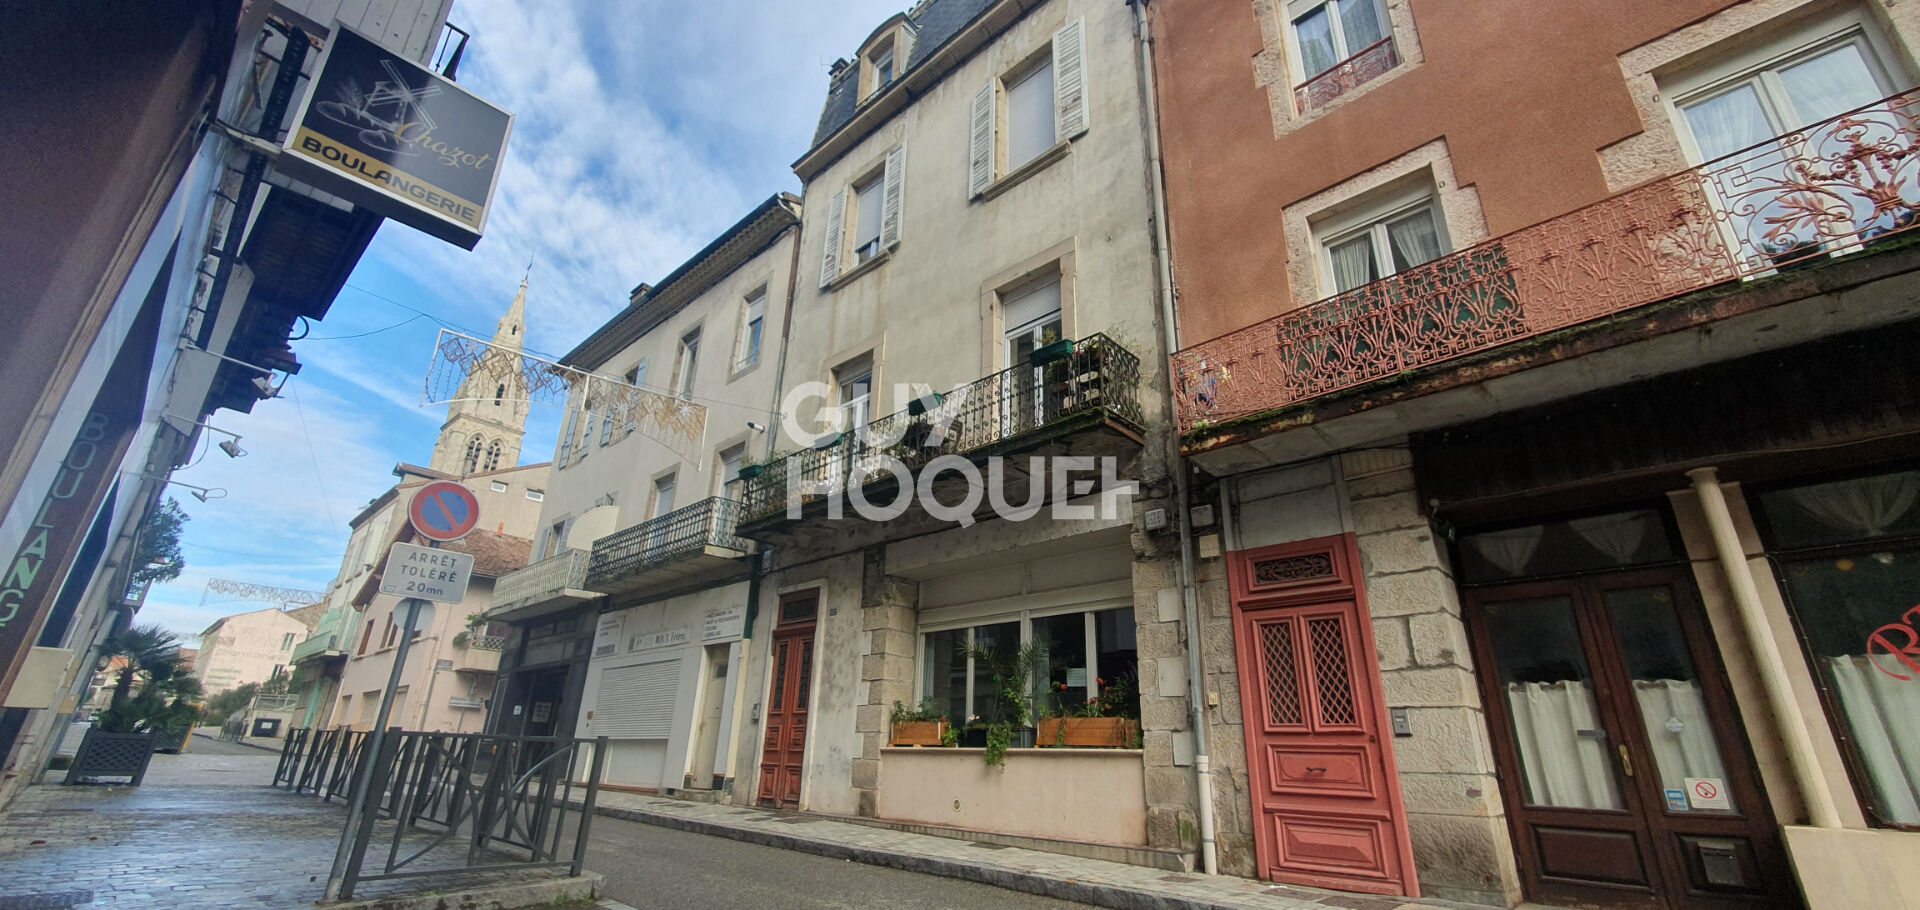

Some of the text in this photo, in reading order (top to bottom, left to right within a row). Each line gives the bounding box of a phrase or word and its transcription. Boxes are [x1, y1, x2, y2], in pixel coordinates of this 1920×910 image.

[395, 121, 493, 170] Chazot
[302, 136, 477, 221] BOULANGERIE
[0, 411, 108, 627] BOULANG
[401, 564, 457, 583] TOLÉRÉ
[409, 552, 457, 568] ARRÊT
[406, 581, 444, 595] 20mn
